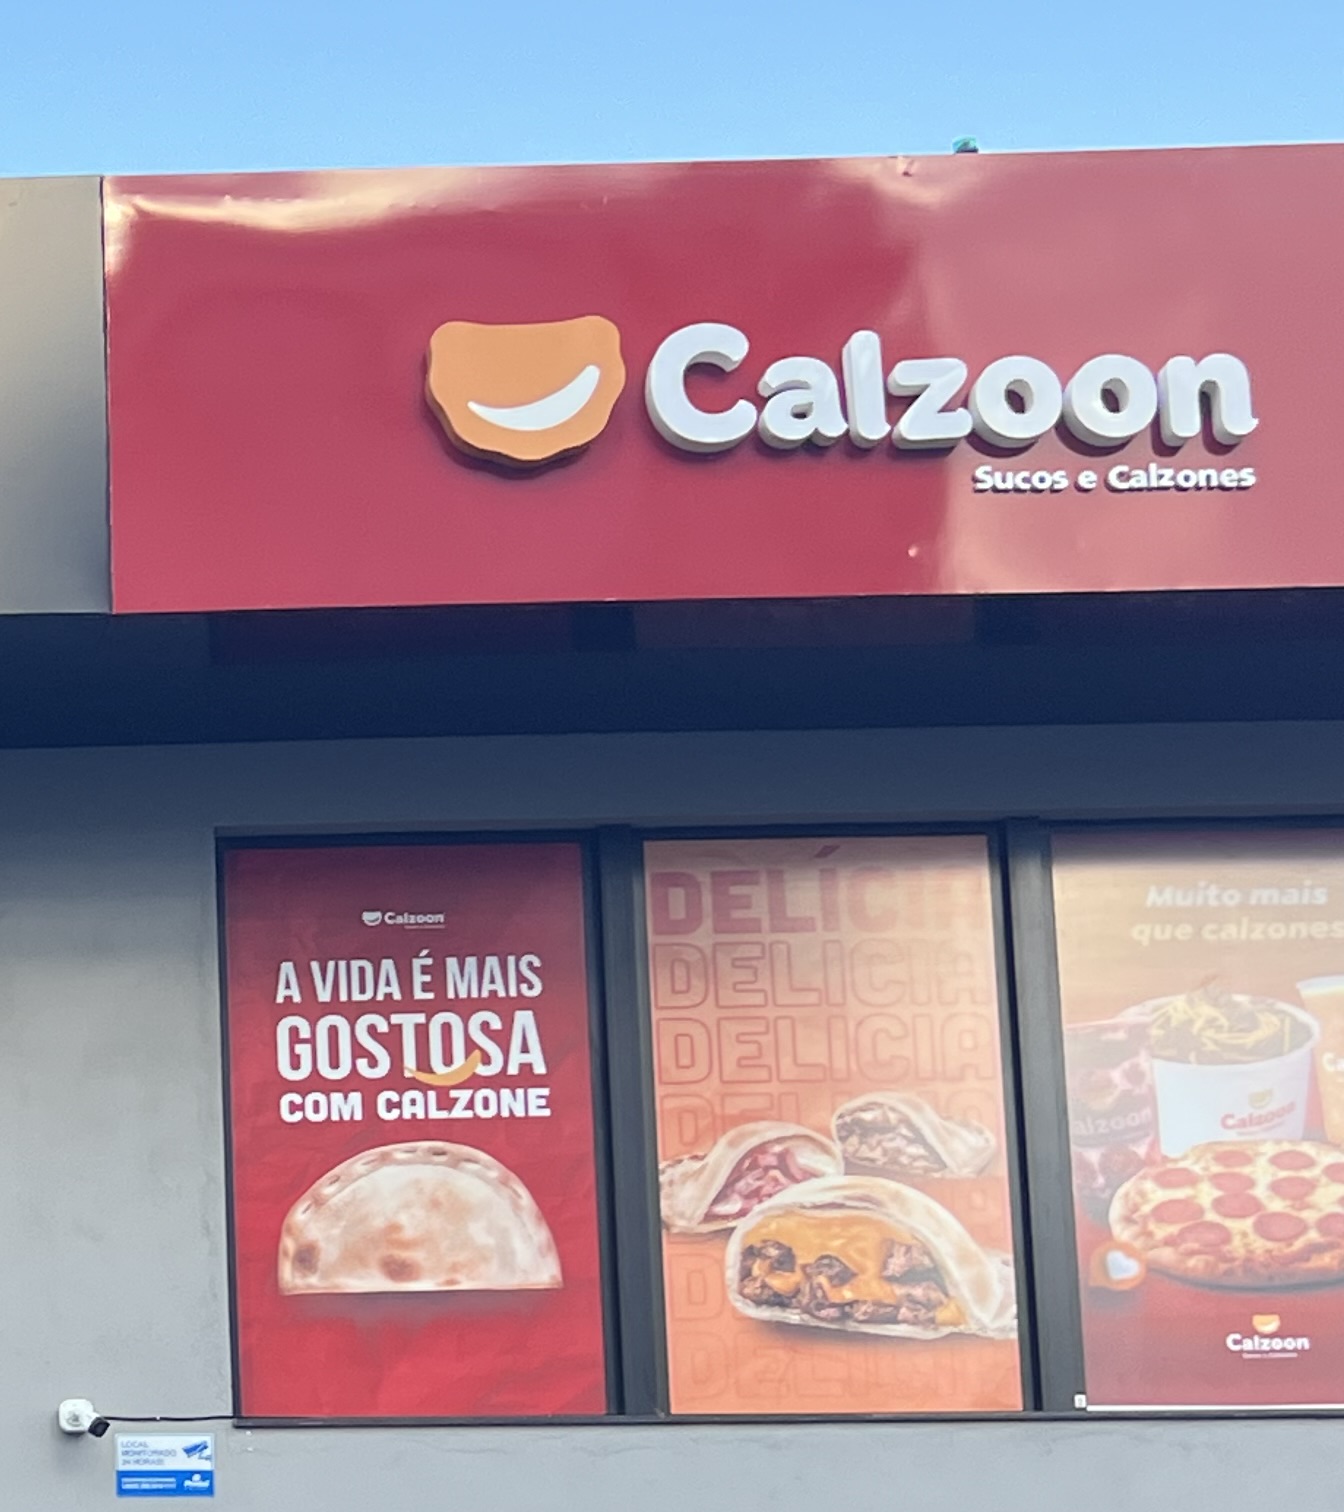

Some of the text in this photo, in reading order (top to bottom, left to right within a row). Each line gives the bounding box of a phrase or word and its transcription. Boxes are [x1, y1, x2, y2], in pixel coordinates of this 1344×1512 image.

[645, 322, 1259, 453] Calzoon
[974, 463, 1257, 491] Sucos e Calzones
[1146, 880, 1328, 908] Muito mais
[384, 911, 445, 925] Calzoon
[1131, 916, 1344, 946] que calzones
[276, 949, 543, 1003] A VIDA É MAIS
[276, 1010, 548, 1081] GOSTOSA
[279, 1087, 551, 1122] COM CALZONE
[1072, 1107, 1153, 1136] alzoon
[1226, 1333, 1310, 1351] Calzoon
